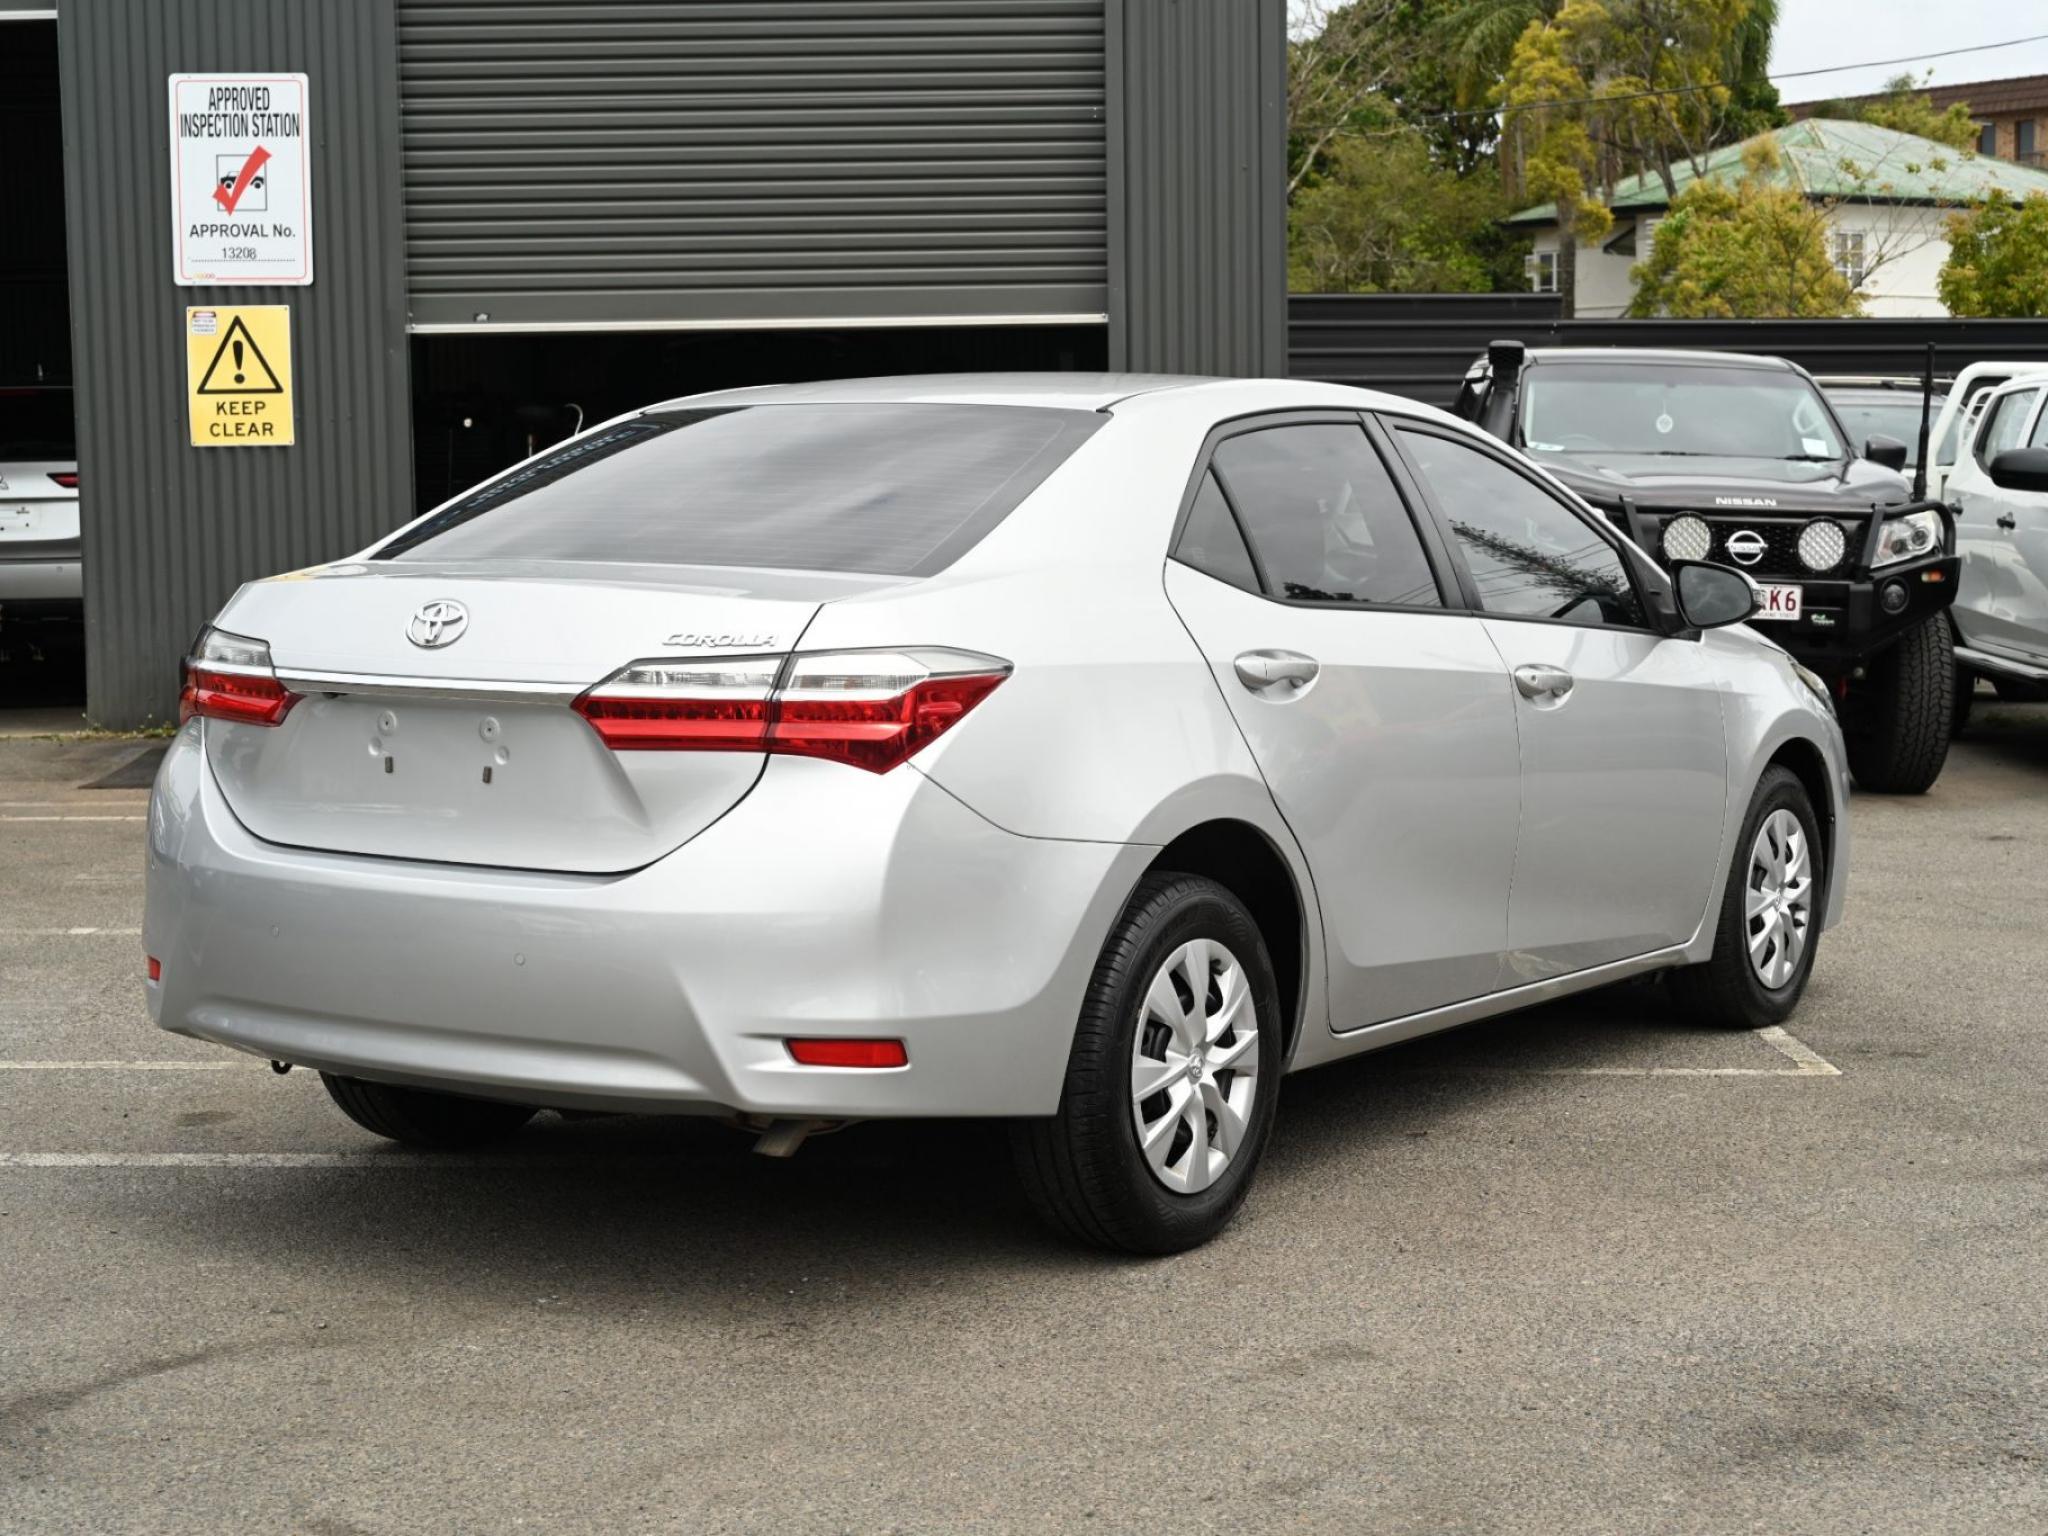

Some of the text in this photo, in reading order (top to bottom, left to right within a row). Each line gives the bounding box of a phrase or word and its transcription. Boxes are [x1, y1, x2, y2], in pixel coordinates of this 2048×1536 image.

[208, 87, 270, 111] APPROVED
[180, 113, 300, 138] INSPECTION STATION
[189, 223, 296, 238] APPROVAL No.
[221, 246, 257, 260] 13208
[216, 401, 266, 416] KEEP
[209, 422, 274, 437] CLEAR
[1715, 496, 1777, 506] NISSAN
[1761, 590, 1797, 612] K6
[662, 633, 778, 648] COROLLA
